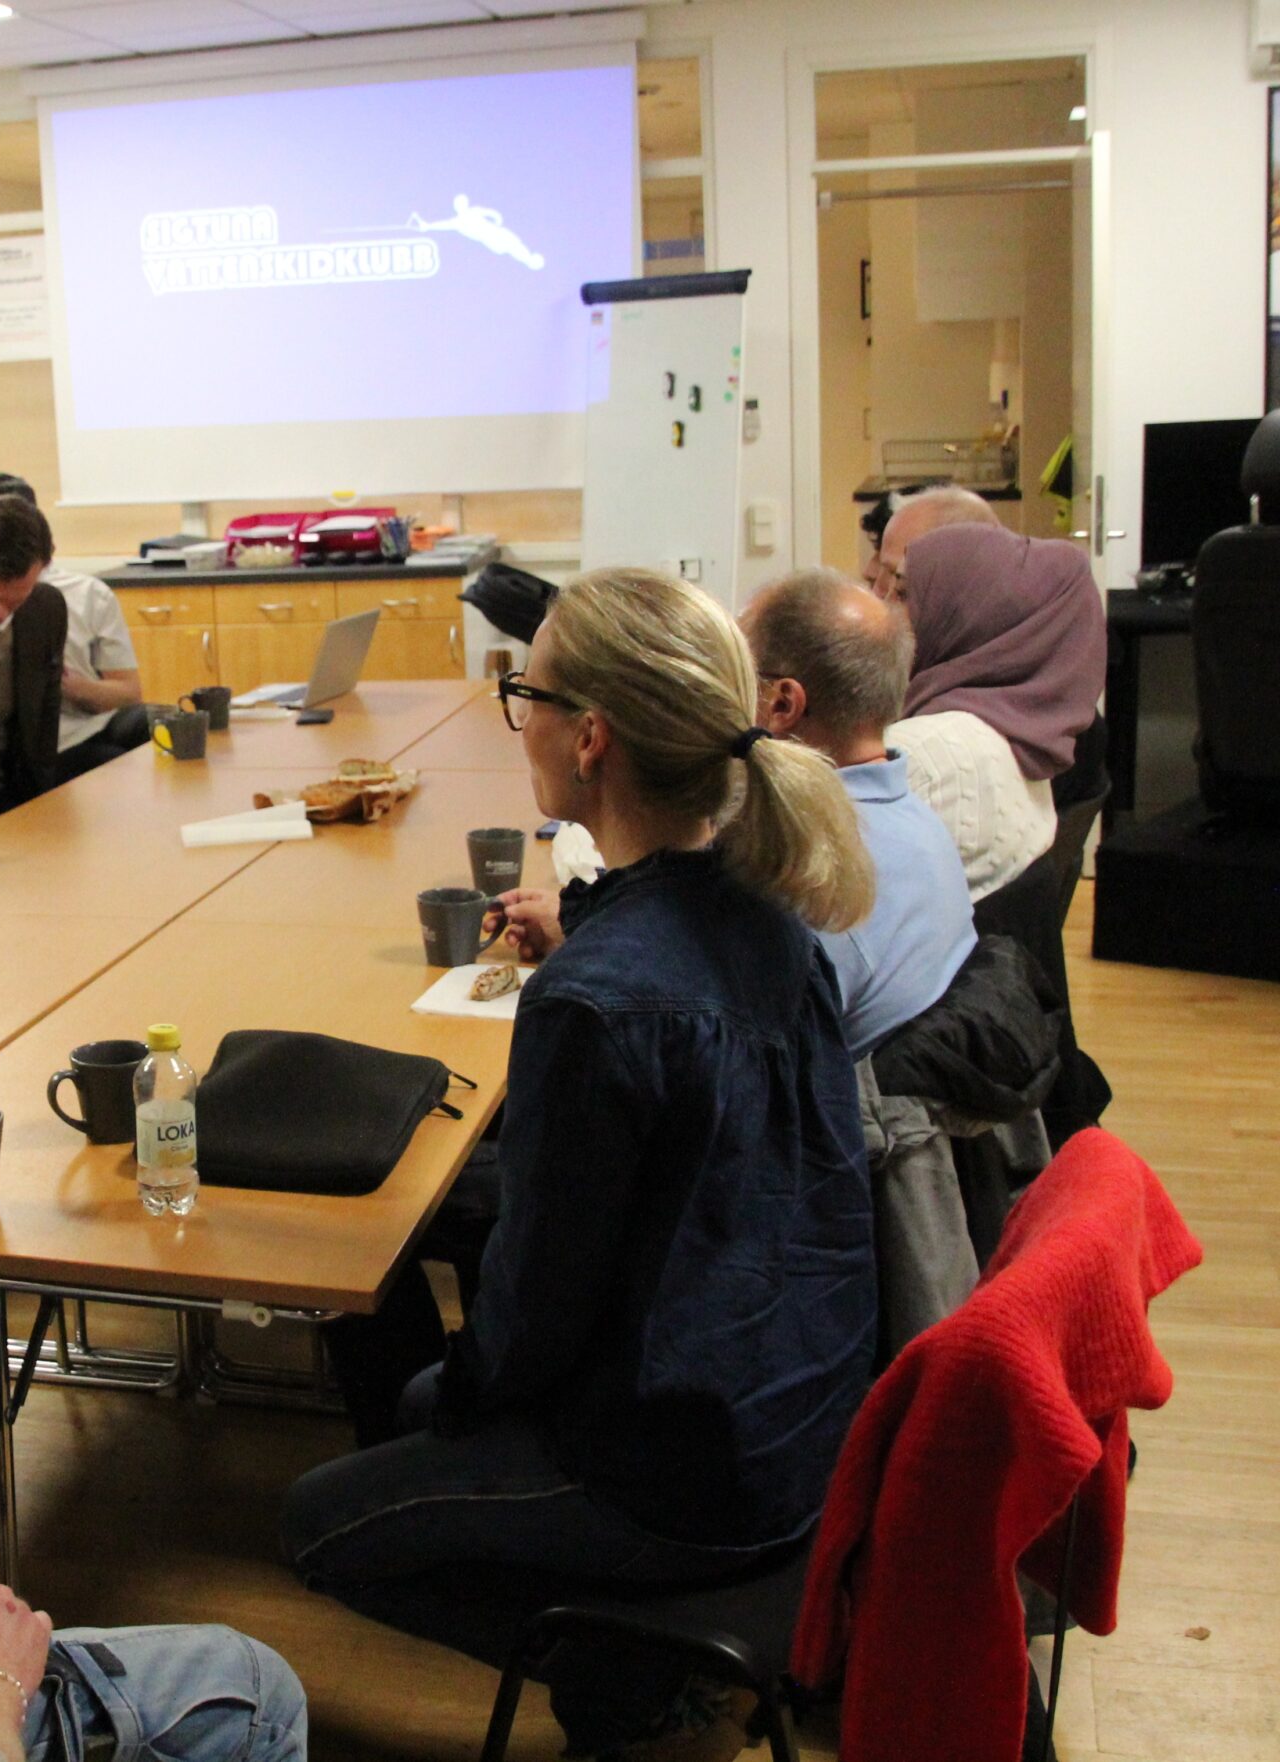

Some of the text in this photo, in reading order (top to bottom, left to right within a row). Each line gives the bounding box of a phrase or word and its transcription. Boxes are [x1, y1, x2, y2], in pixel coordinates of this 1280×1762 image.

[144, 209, 274, 249] SIGTUNA
[146, 243, 434, 290] VATTENSKIDKLUBB
[157, 1121, 194, 1141] LOKA
